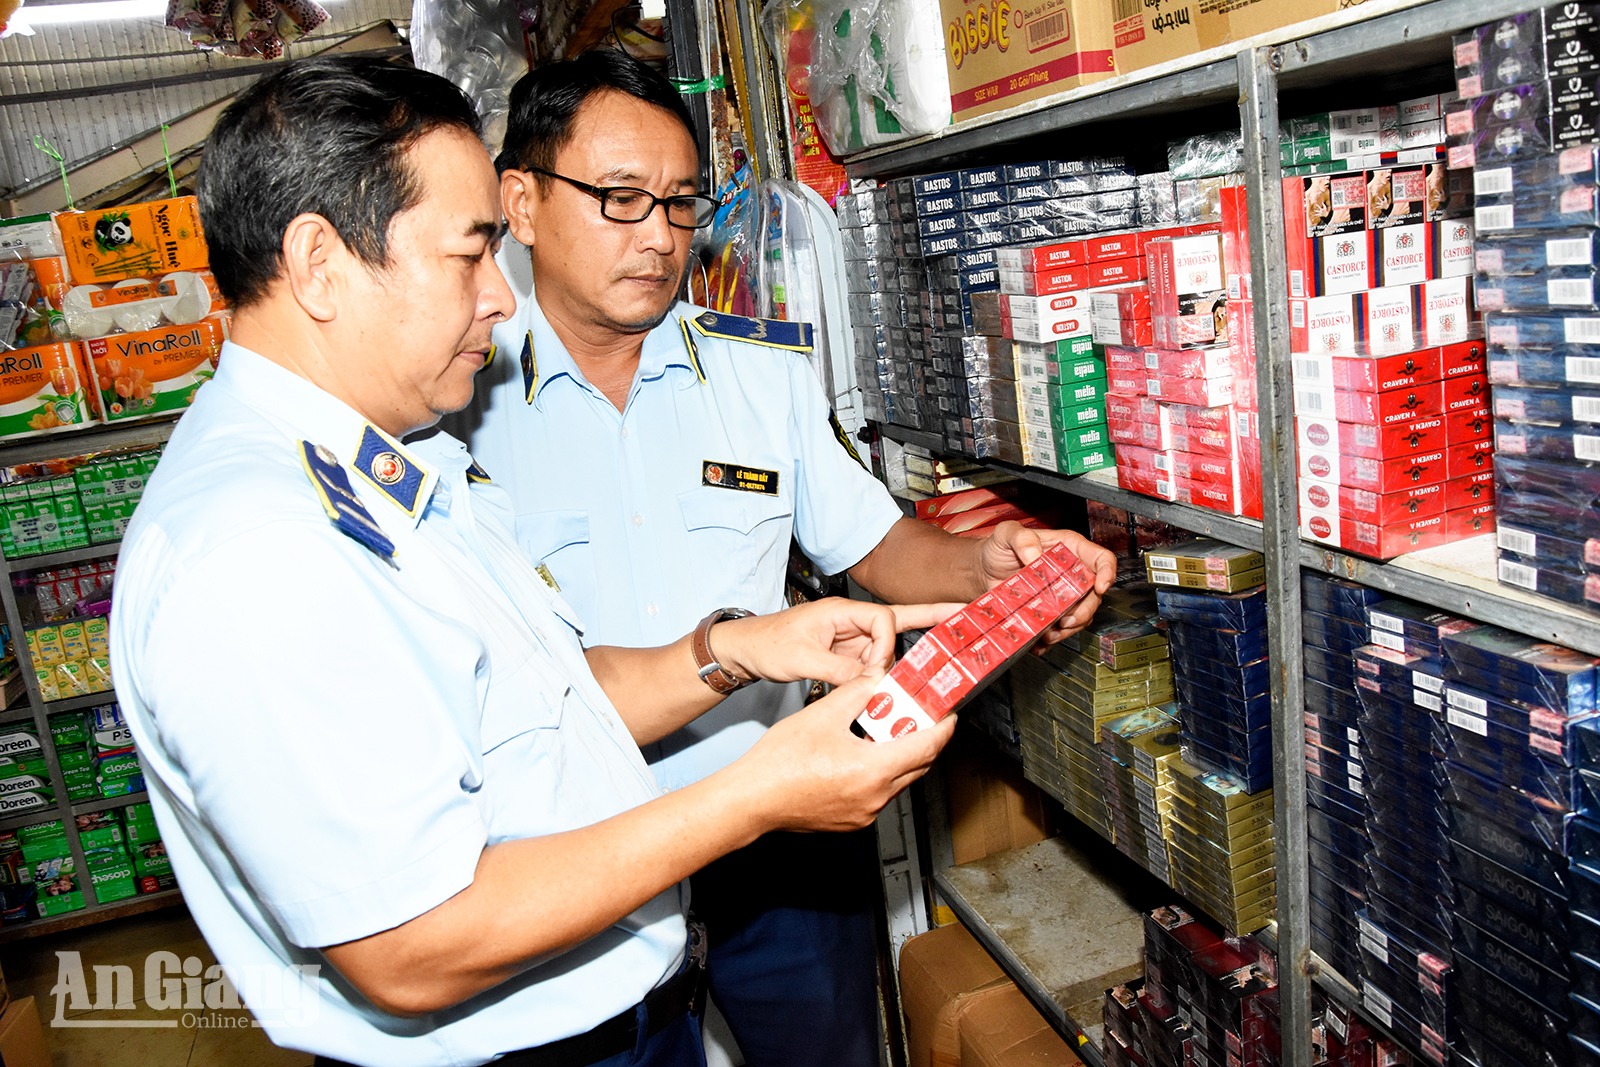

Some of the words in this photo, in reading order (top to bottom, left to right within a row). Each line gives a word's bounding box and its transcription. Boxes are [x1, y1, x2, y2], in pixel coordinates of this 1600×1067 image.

[1552, 20, 1575, 30] CRAVEN
[1576, 17, 1593, 26] WILD
[1554, 57, 1577, 67] CRAVEN
[1578, 54, 1594, 63] WILD
[1010, 80, 1017, 90] 20
[974, 90, 986, 101] SIZE
[1558, 94, 1579, 103] CRAVEN
[1580, 91, 1594, 100] WILD
[1559, 131, 1580, 140] CRAVEN
[1581, 128, 1594, 137] WILD
[1015, 166, 1040, 178] BASTOS
[1059, 161, 1083, 173] BASTOS
[924, 178, 951, 191] BASTOS
[970, 172, 997, 185] BASTOS
[972, 191, 998, 205] BASTOS
[1018, 186, 1044, 198] BASTOS
[927, 198, 953, 212] BASTOS
[974, 212, 1000, 225] BASTOS
[1018, 206, 1044, 218] BASTOS
[929, 218, 956, 232] BASTOS
[1021, 225, 1046, 238] BASTOS
[156, 205, 171, 236] Ngọc
[166, 241, 180, 268] Huệ
[976, 231, 1002, 244] BASTOS
[931, 238, 958, 252] BASTOS
[1101, 242, 1121, 252] BASTION
[967, 252, 992, 265] BASTOS
[1049, 250, 1070, 260] BASTION
[1386, 253, 1423, 267] CASTORCE
[1103, 266, 1123, 276] BASTION
[1327, 261, 1366, 275] CASTORCE
[969, 272, 994, 285] BASTOS
[1052, 275, 1072, 284] BASTION
[1428, 297, 1464, 310] CASTORCE
[1371, 306, 1409, 320] CASTORCE
[1311, 315, 1351, 329] CASTORCE
[116, 330, 201, 357] VinaRoll
[1072, 343, 1092, 355] mélia
[1074, 363, 1095, 377] mélia
[1448, 366, 1473, 375] CRAVEN
[3, 372, 43, 386] PREMIER
[1383, 379, 1408, 389] CRAVEN
[1075, 384, 1096, 399] mélia
[1450, 399, 1474, 409] CRAVEN
[1077, 407, 1098, 420] mélia
[1385, 413, 1410, 422] CRAVEN
[1416, 420, 1441, 430] CRAVEN
[1079, 430, 1100, 444] mélia
[1083, 452, 1103, 465] mélia
[1417, 453, 1442, 463] CRAVEN
[1201, 463, 1226, 475] CASTORCE
[1203, 489, 1228, 502] CASTORCE
[1414, 485, 1440, 496] CRAVEN
[1309, 524, 1330, 533] CRAVEN
[1416, 517, 1440, 528] CRAVEN
[867, 694, 893, 720] CRAVEN
[62, 724, 79, 732] Xanh
[0, 779, 35, 792] Doreen
[1, 796, 37, 809] Doreen
[24, 820, 56, 831] closeup
[1480, 824, 1535, 861] SAIGON
[1483, 867, 1536, 907] SAIGON
[1485, 904, 1539, 946] SAIGON
[1486, 942, 1539, 984] SAIGON
[1485, 980, 1538, 1023] SAIGON
